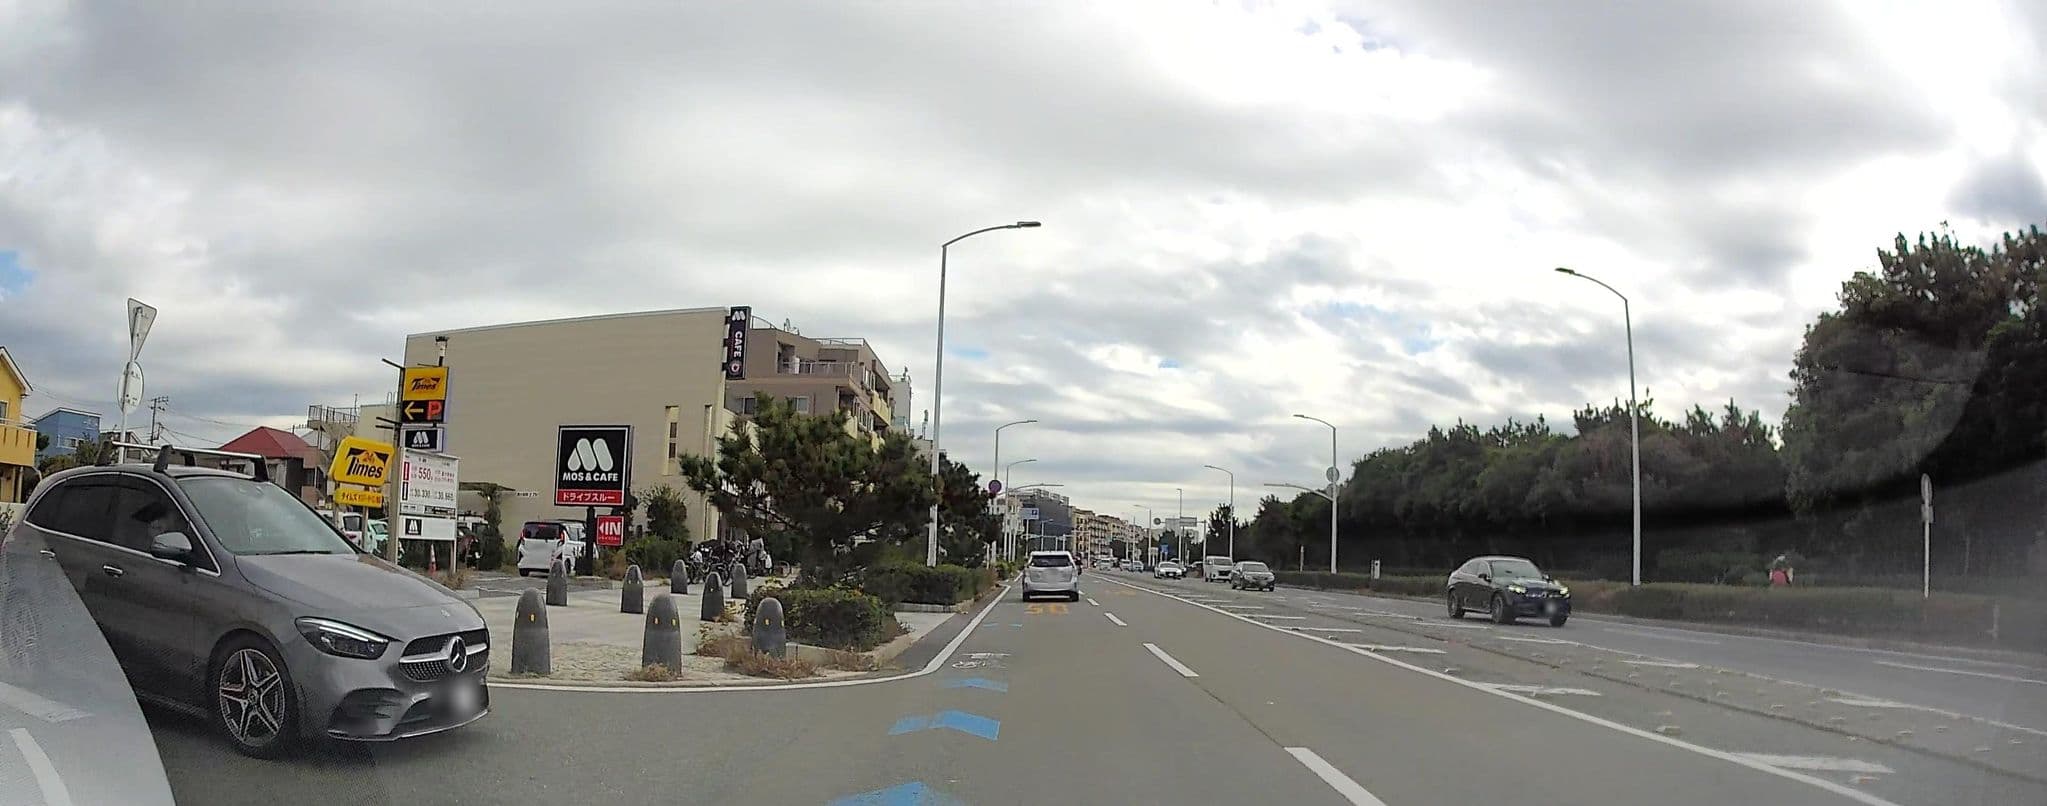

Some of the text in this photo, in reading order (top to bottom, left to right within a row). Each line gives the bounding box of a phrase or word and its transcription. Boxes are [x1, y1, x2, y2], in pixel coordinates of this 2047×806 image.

[733, 330, 743, 357] CAFE
[411, 377, 441, 392] Times
[427, 400, 442, 420] P
[346, 447, 390, 479] Times
[562, 492, 615, 502] ドライブスルー
[604, 521, 622, 536] IN
